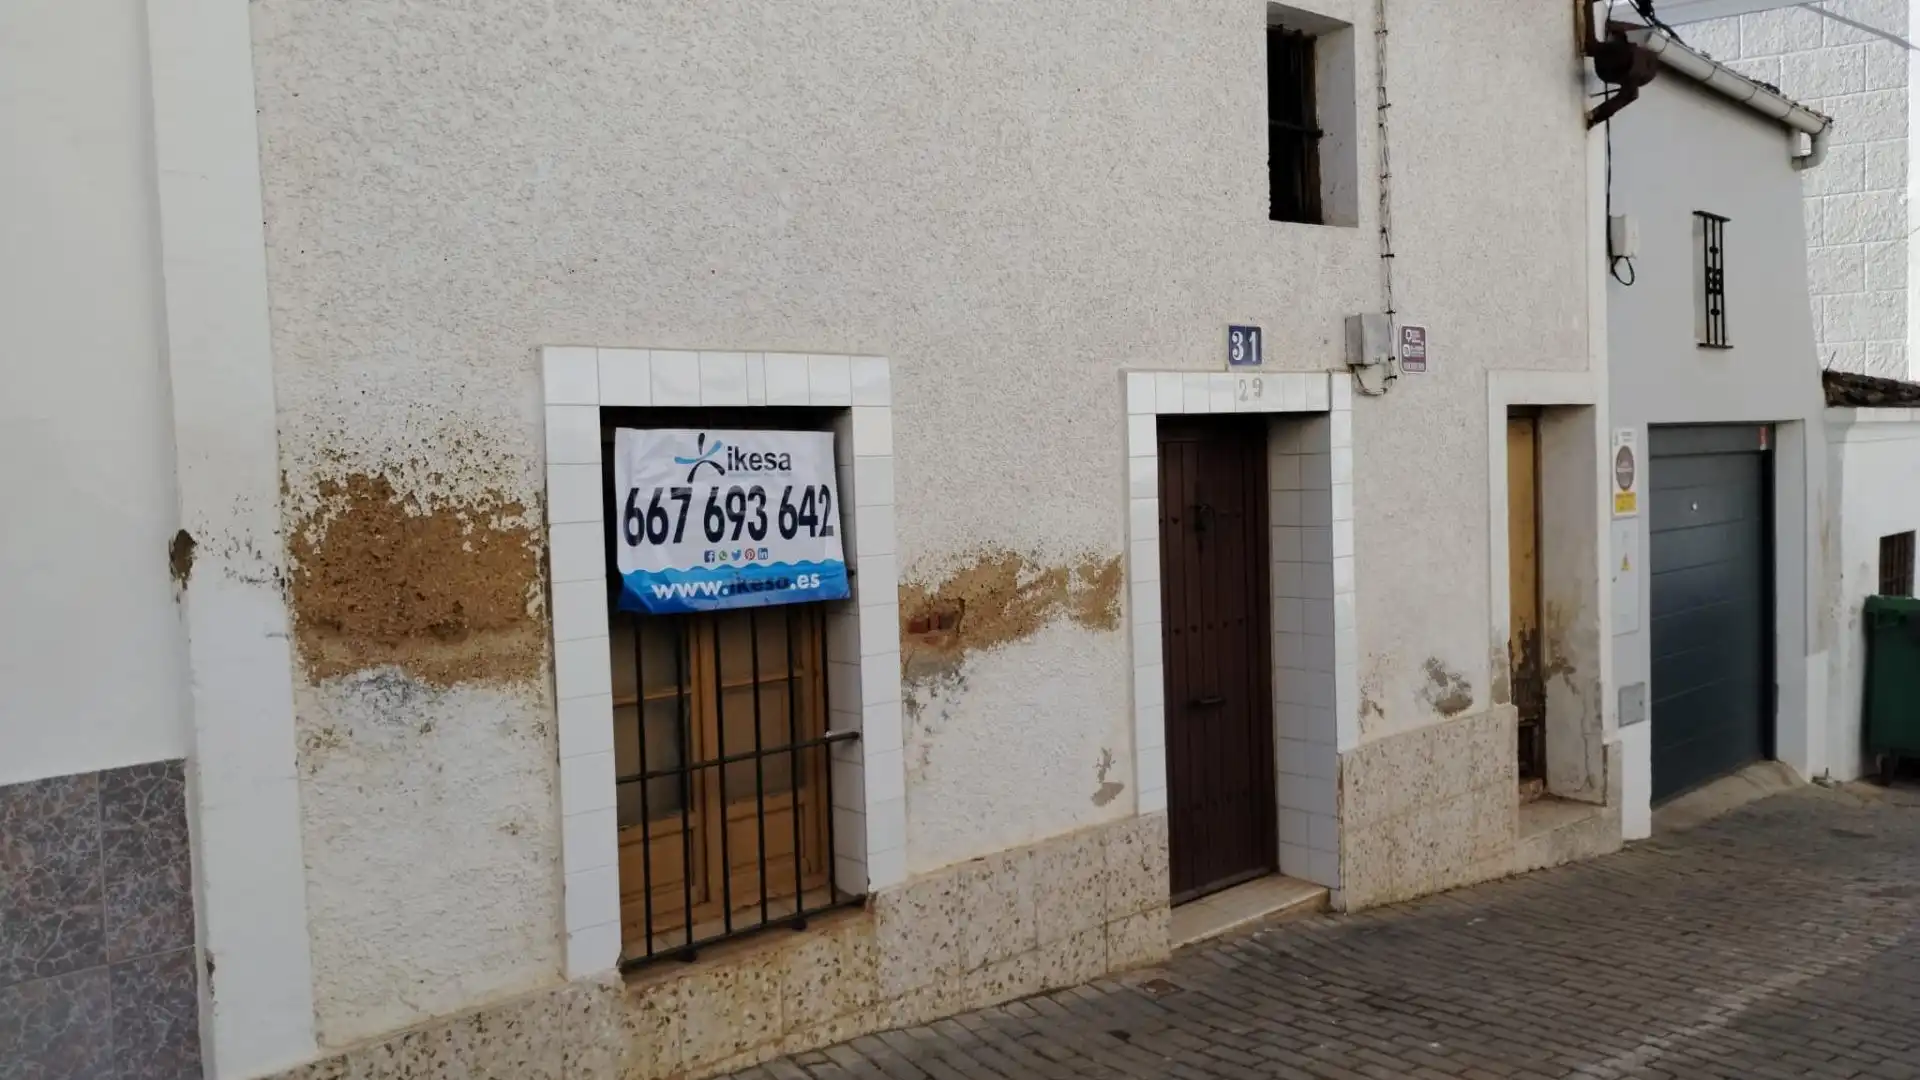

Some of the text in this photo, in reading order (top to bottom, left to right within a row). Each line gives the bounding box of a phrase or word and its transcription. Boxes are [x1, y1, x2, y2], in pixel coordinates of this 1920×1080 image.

[1231, 330, 1257, 362] 31
[1239, 377, 1263, 402] 29
[727, 445, 792, 471] ikesa
[623, 484, 834, 547] 667 693 642
